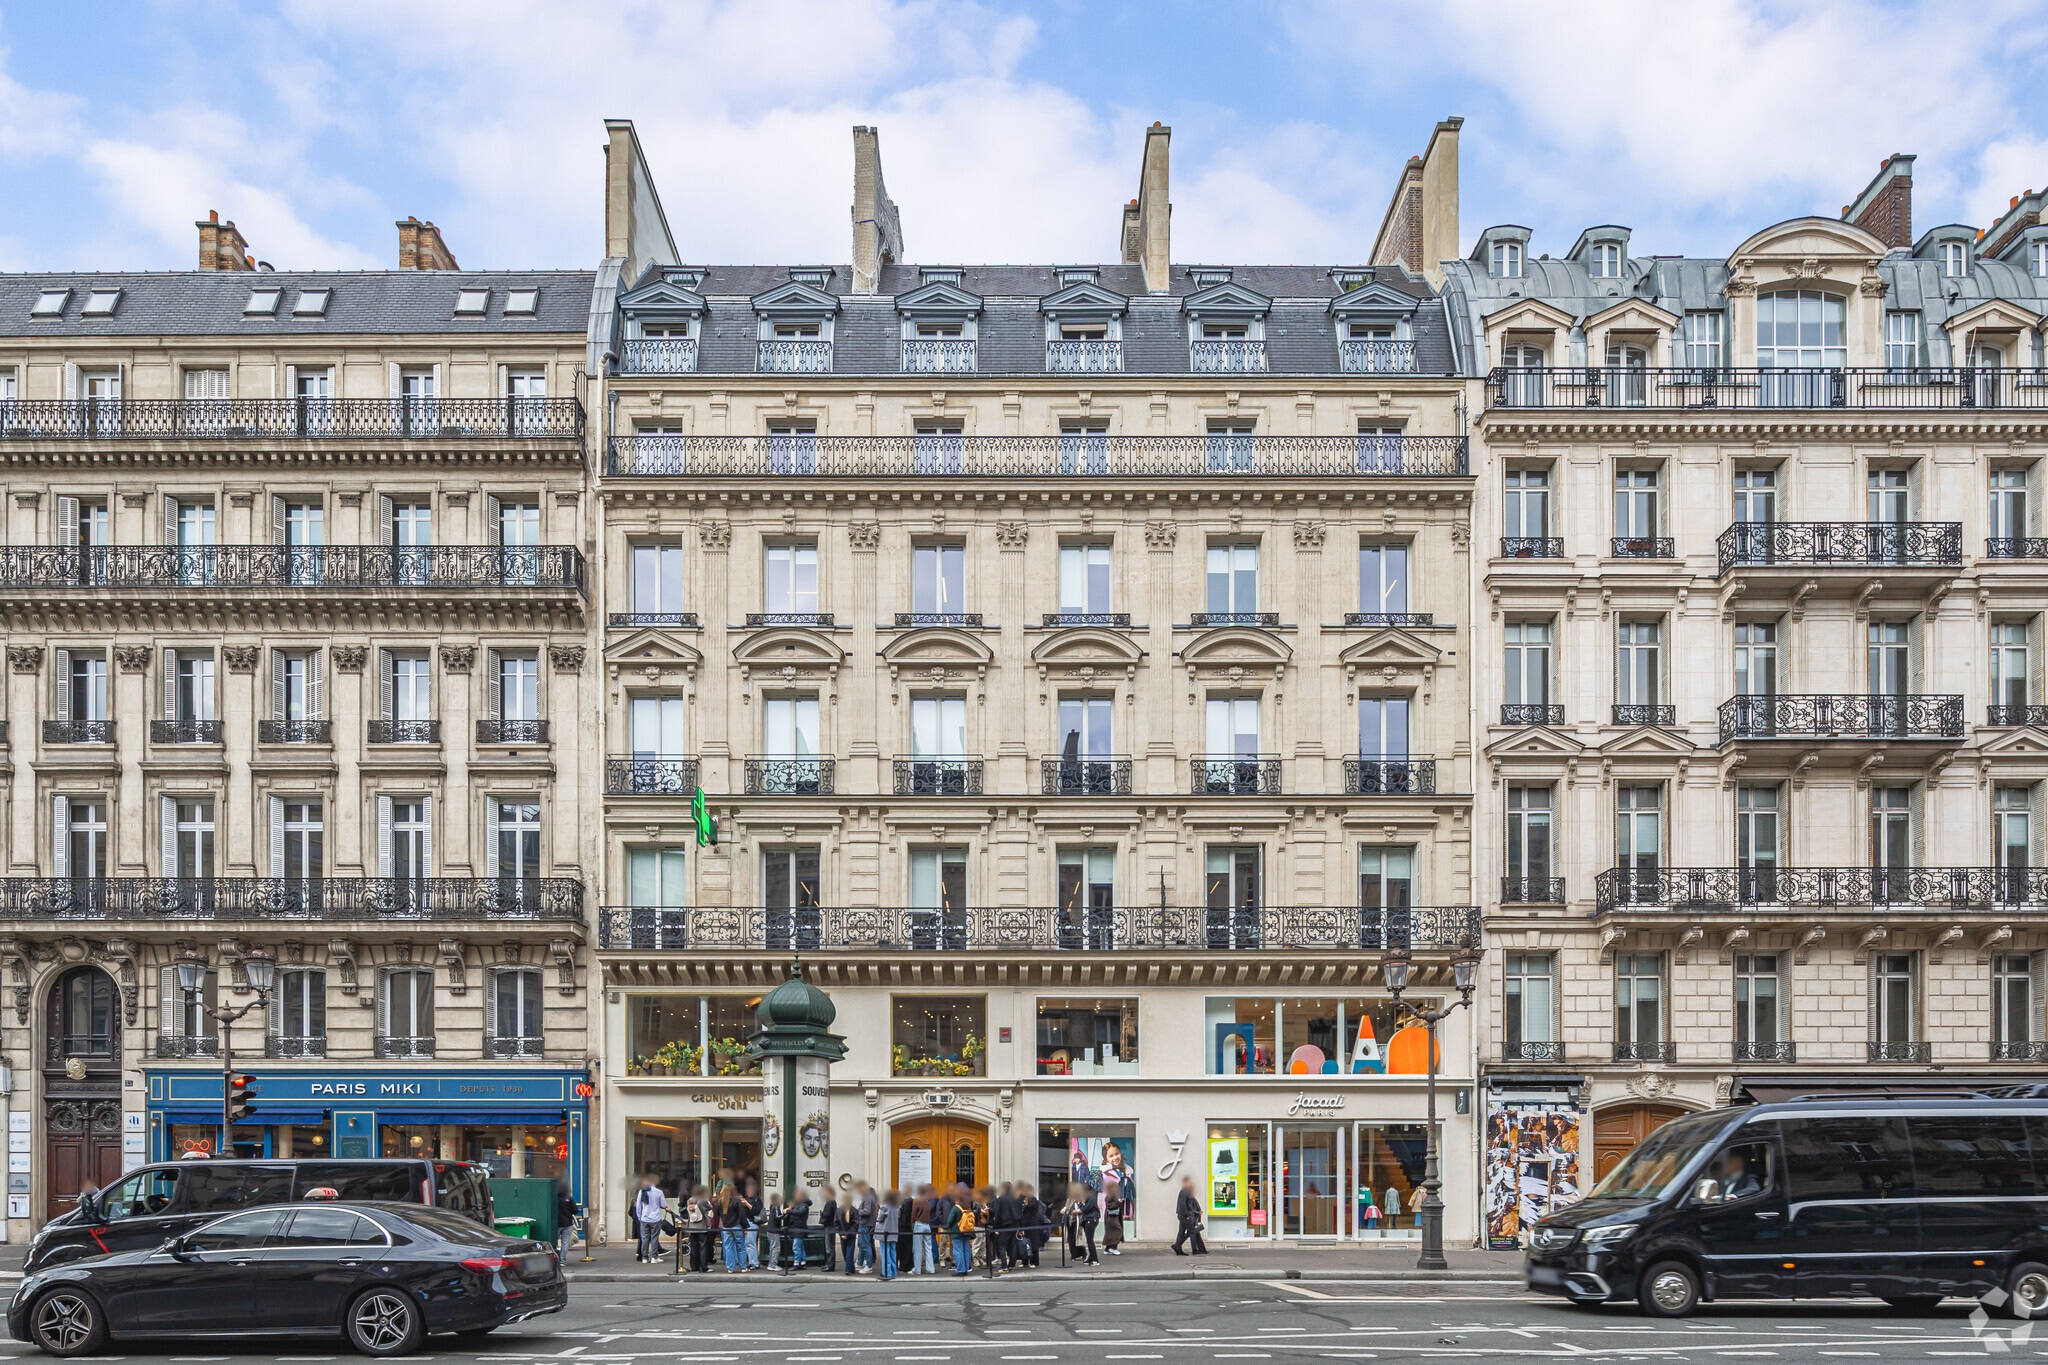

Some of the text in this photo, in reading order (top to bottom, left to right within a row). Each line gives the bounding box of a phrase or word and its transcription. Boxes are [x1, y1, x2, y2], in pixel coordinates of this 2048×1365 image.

[311, 1083, 421, 1095] PARIS MIKI
[459, 1085, 523, 1094] DEPUIS 1930
[717, 1102, 748, 1111] OPERA
[1303, 1108, 1336, 1117] PARIS
[323, 1189, 336, 1197] TAXI
